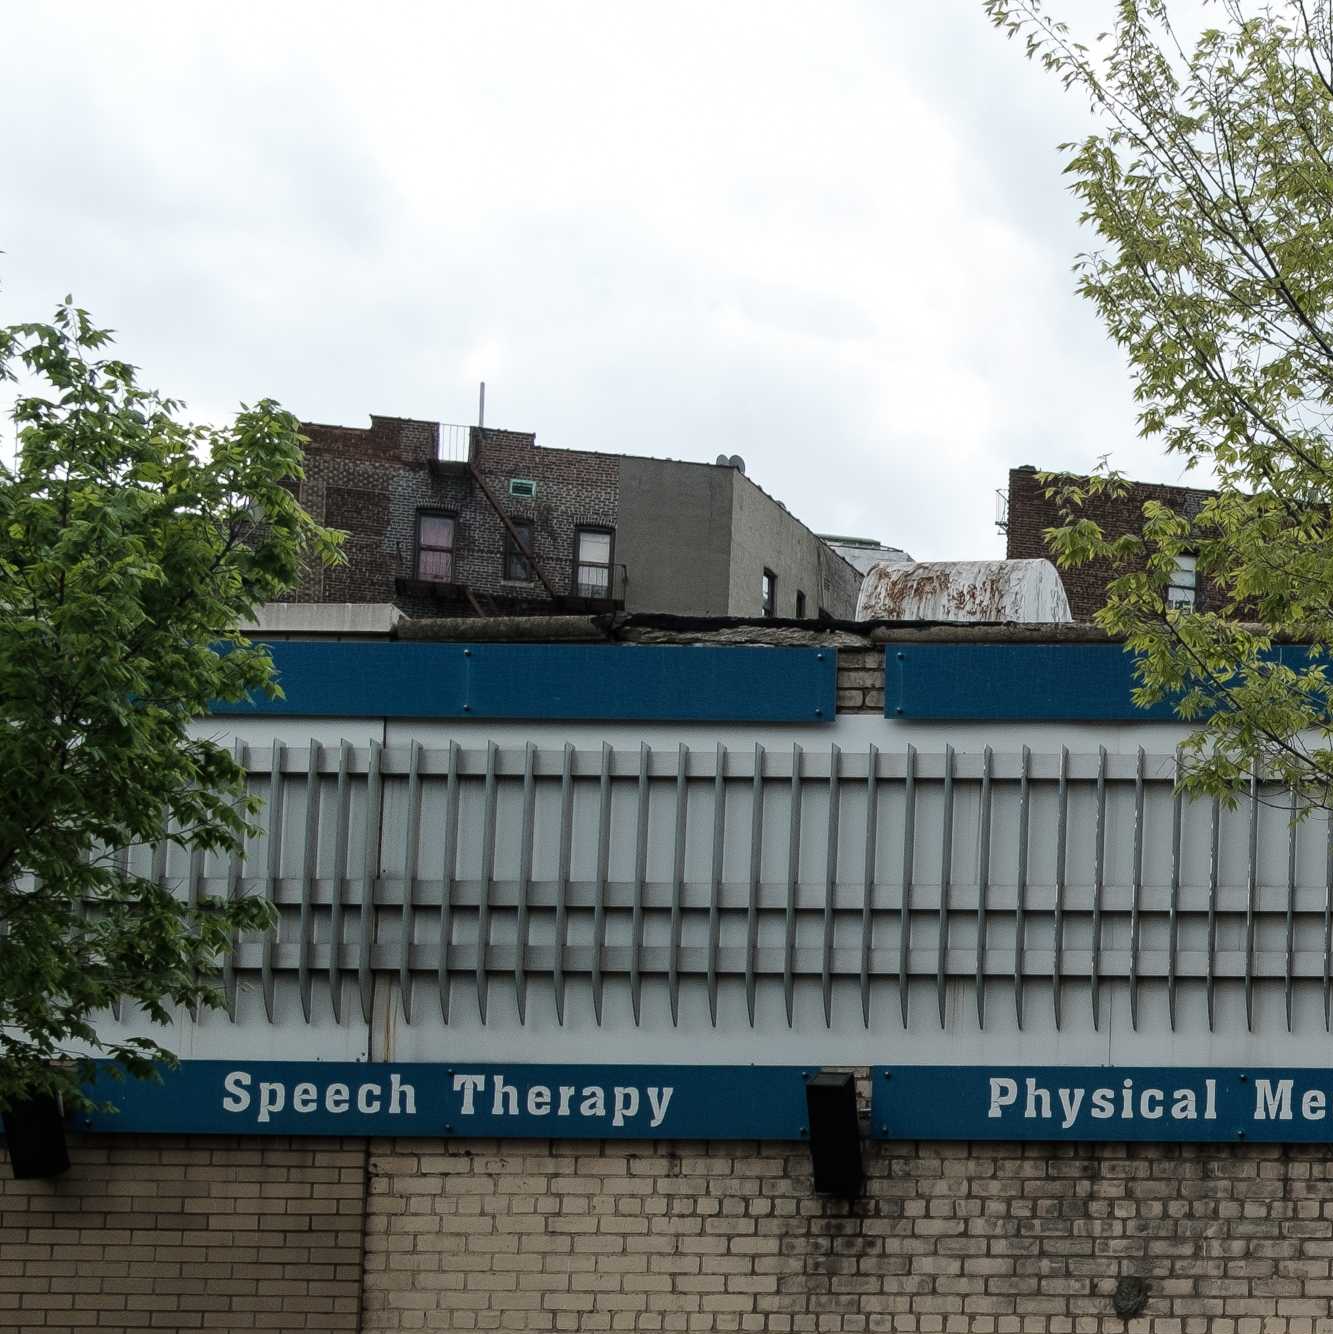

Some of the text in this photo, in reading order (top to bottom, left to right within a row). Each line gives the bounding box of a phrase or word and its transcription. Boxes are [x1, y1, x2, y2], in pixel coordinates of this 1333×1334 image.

[223, 1071, 674, 1127] Speech Therapy
[988, 1077, 1217, 1129] Physical
